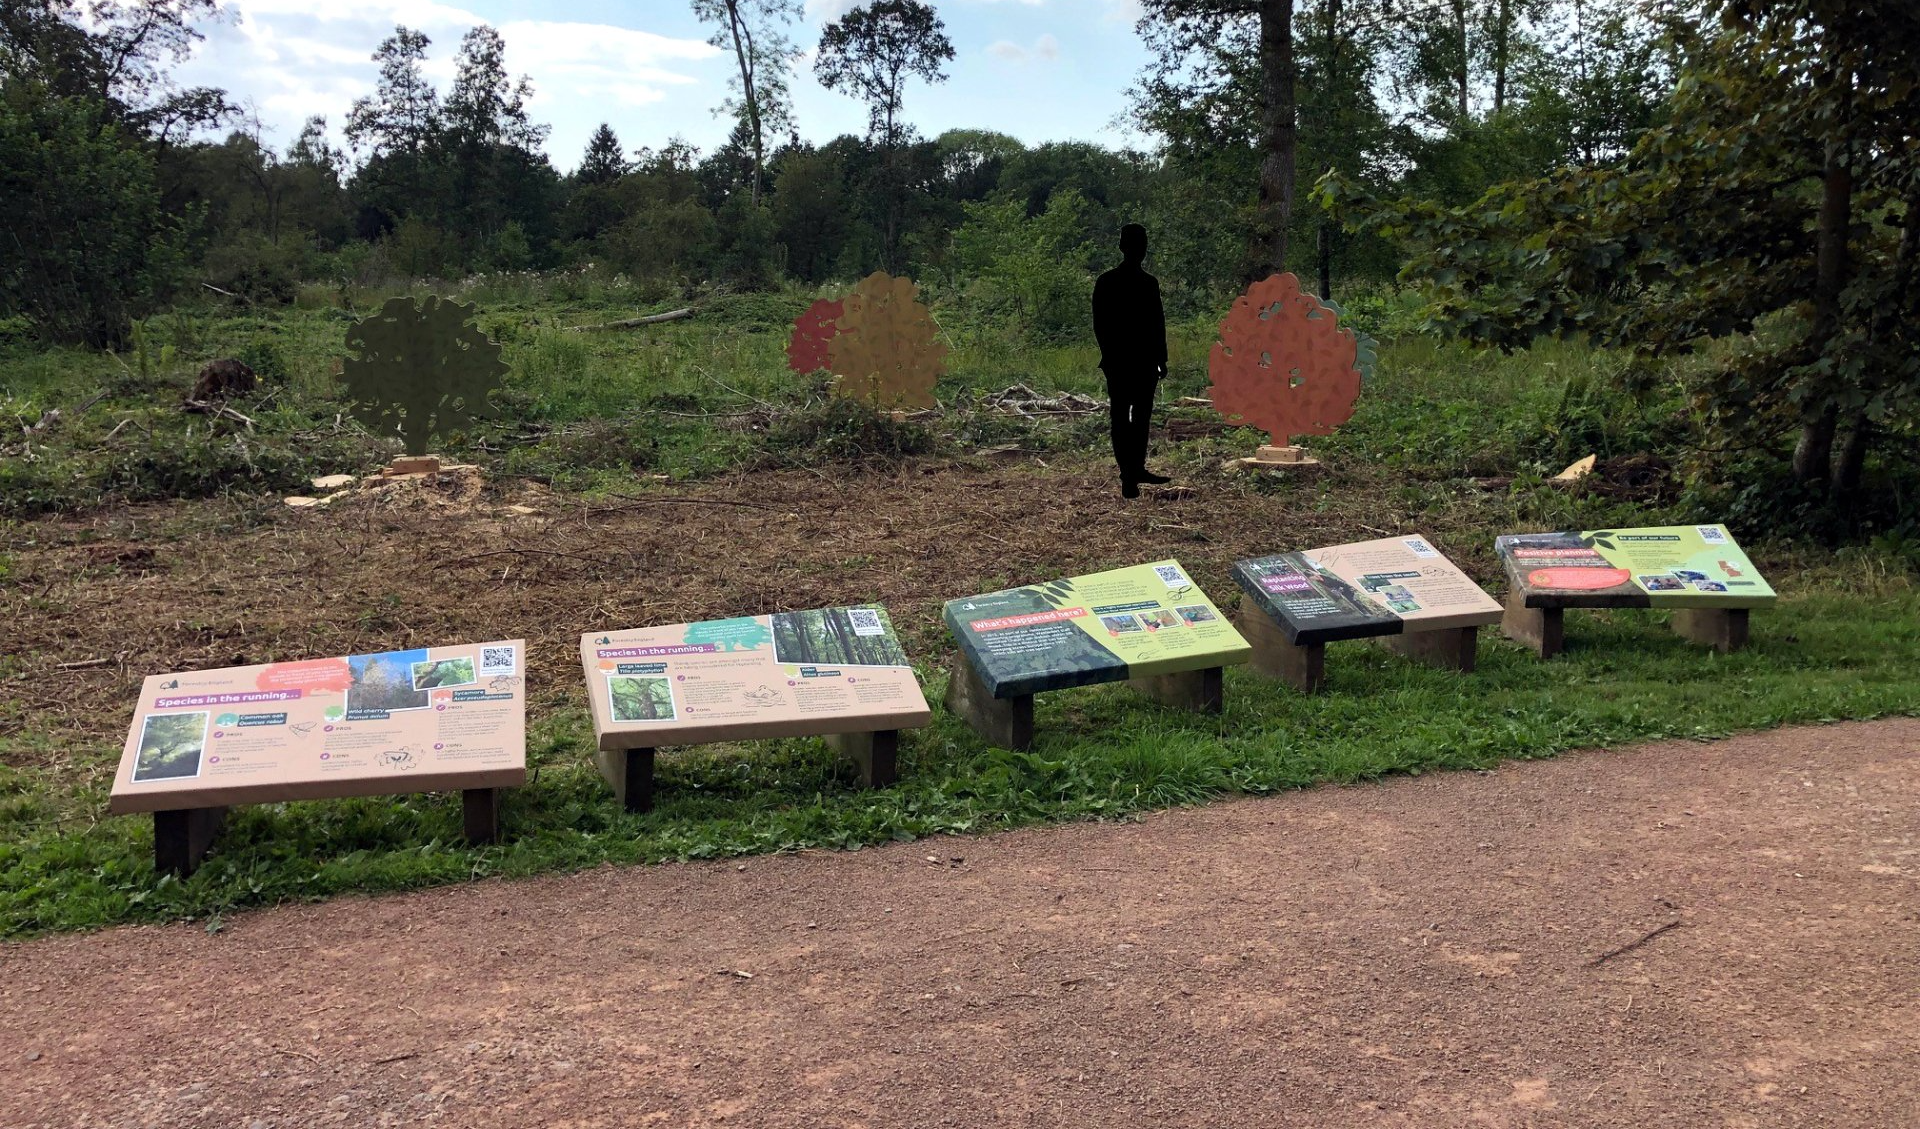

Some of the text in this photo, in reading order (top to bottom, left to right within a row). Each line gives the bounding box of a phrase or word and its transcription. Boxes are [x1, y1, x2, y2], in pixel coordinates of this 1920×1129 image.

[1261, 575, 1306, 583] Replanting
[1269, 582, 1309, 592] Silk Wood
[974, 609, 1083, 629] What's happened here?
[157, 698, 204, 708] Species
[242, 691, 299, 701] running...
